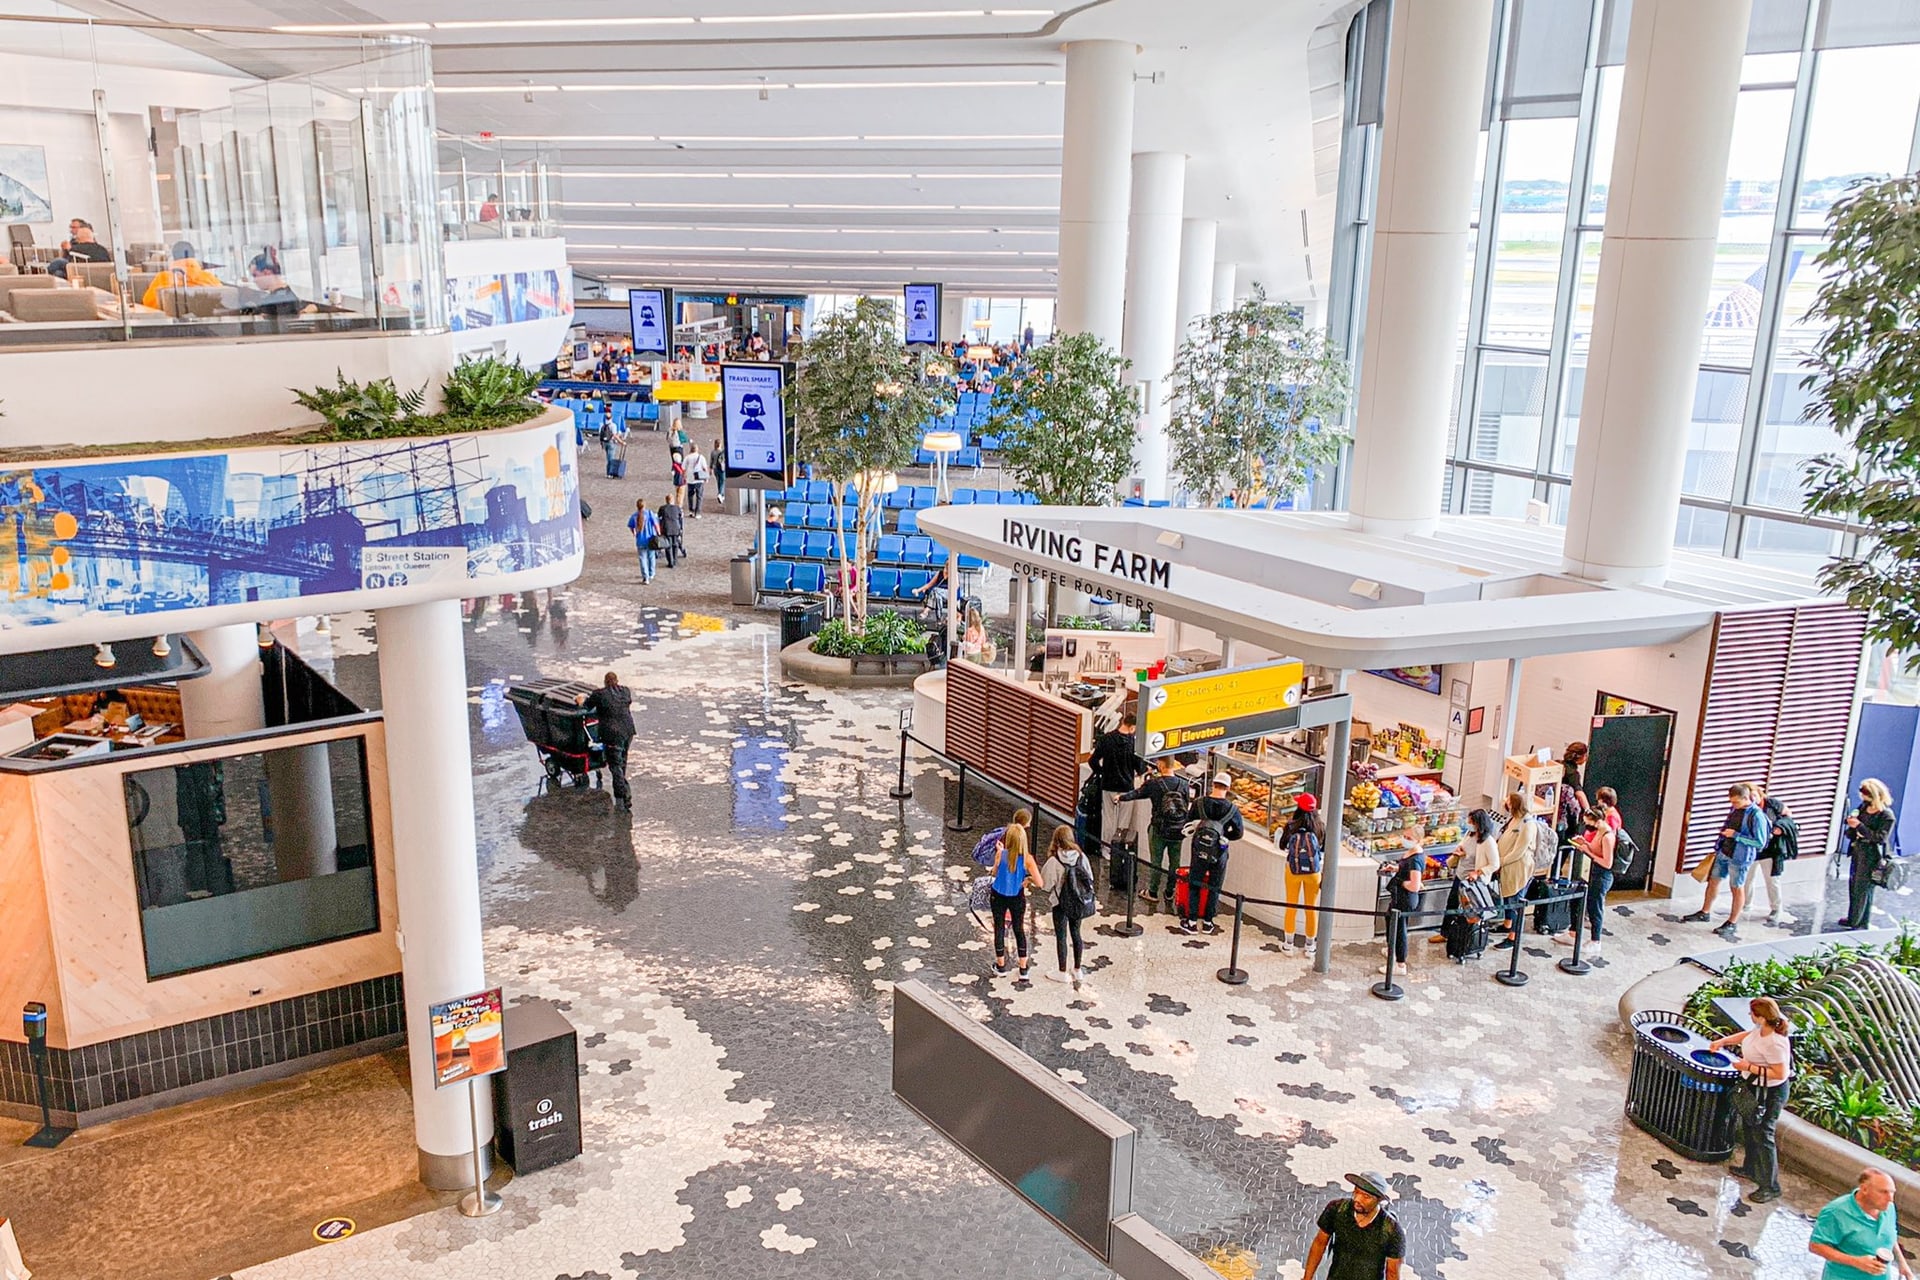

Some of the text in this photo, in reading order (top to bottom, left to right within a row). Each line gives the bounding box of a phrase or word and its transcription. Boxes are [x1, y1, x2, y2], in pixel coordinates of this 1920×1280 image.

[728, 375, 750, 383] TRAVEL
[376, 552, 409, 562] Street
[413, 551, 450, 561] Station
[1002, 519, 1171, 589] IRVING FARM
[1013, 561, 1154, 614] COFFEE ROASTERS
[1185, 686, 1210, 697] Gates
[1205, 696, 1266, 715] Gates 42 to 47
[1452, 711, 1462, 725] A
[1181, 726, 1225, 742] Elevators
[447, 997, 483, 1012] We Have
[442, 1005, 490, 1023] Beer & Wine
[528, 1111, 563, 1131] trash
